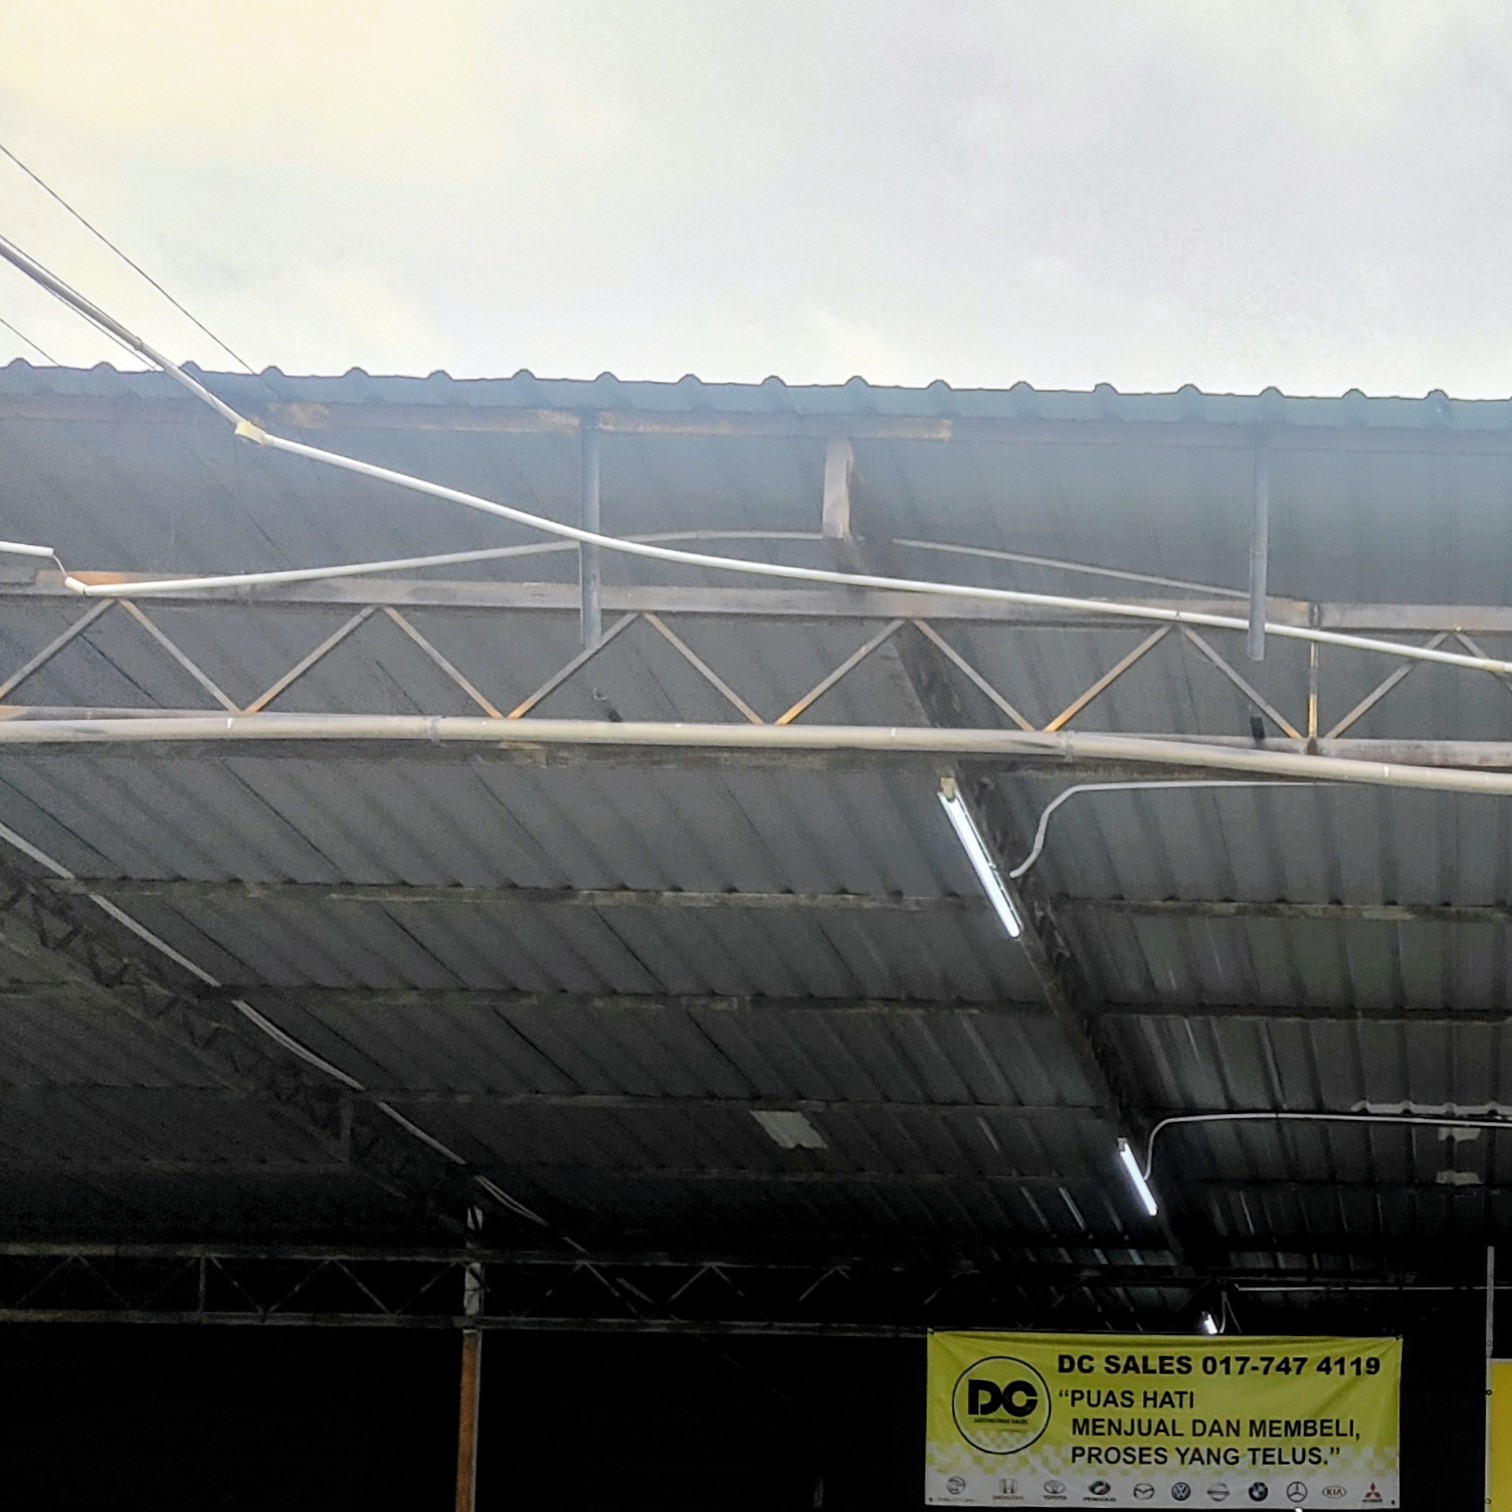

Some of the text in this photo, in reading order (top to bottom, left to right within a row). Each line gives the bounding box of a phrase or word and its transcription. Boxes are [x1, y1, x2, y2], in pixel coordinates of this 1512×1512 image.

[1058, 1354, 1381, 1376] DC SALES 017-747 4119
[967, 1379, 1039, 1418] DC
[1059, 1389, 1194, 1409] “PUAS HATI
[1072, 1418, 1360, 1441] MENJUAL DAN MEMBELI,
[1071, 1446, 1341, 1466] PROSES YANG TELUS.”
[1326, 1488, 1343, 1497] KIA
